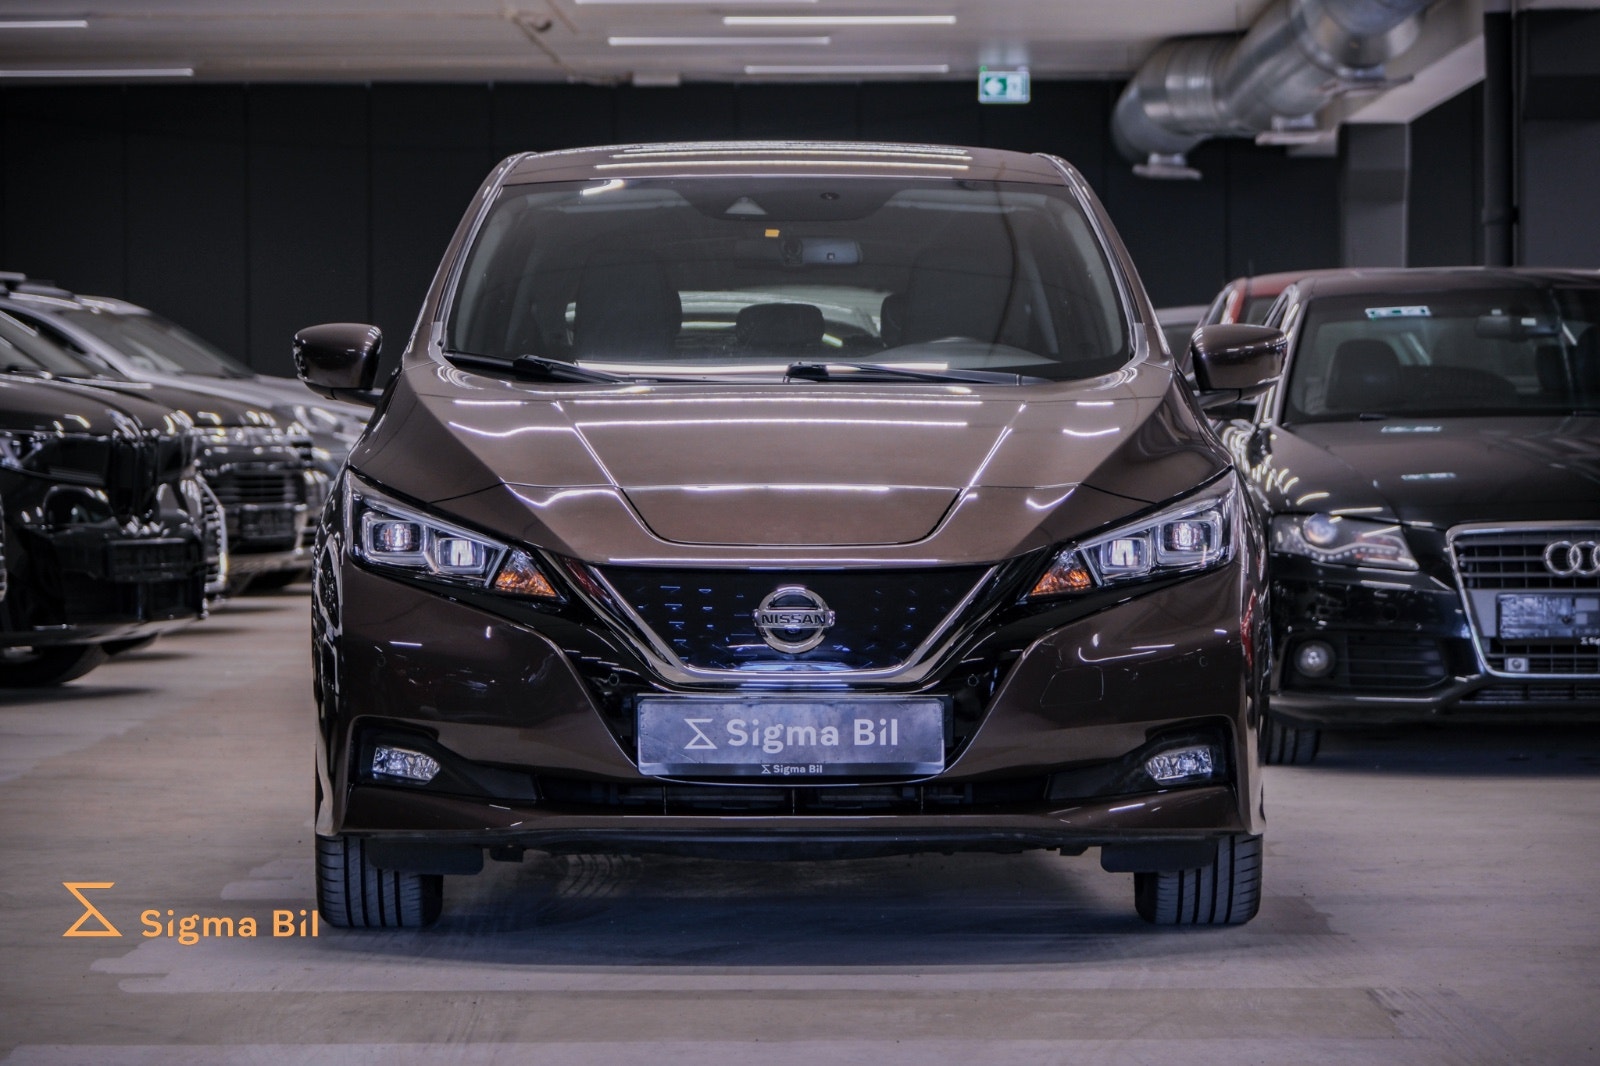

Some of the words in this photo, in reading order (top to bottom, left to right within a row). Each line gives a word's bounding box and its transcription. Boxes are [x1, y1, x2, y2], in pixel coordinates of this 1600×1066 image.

[761, 614, 826, 624] NISSAN
[726, 718, 839, 753] Sigma
[854, 719, 898, 746] Bil
[773, 764, 806, 775] Sigma
[809, 764, 823, 774] Bil
